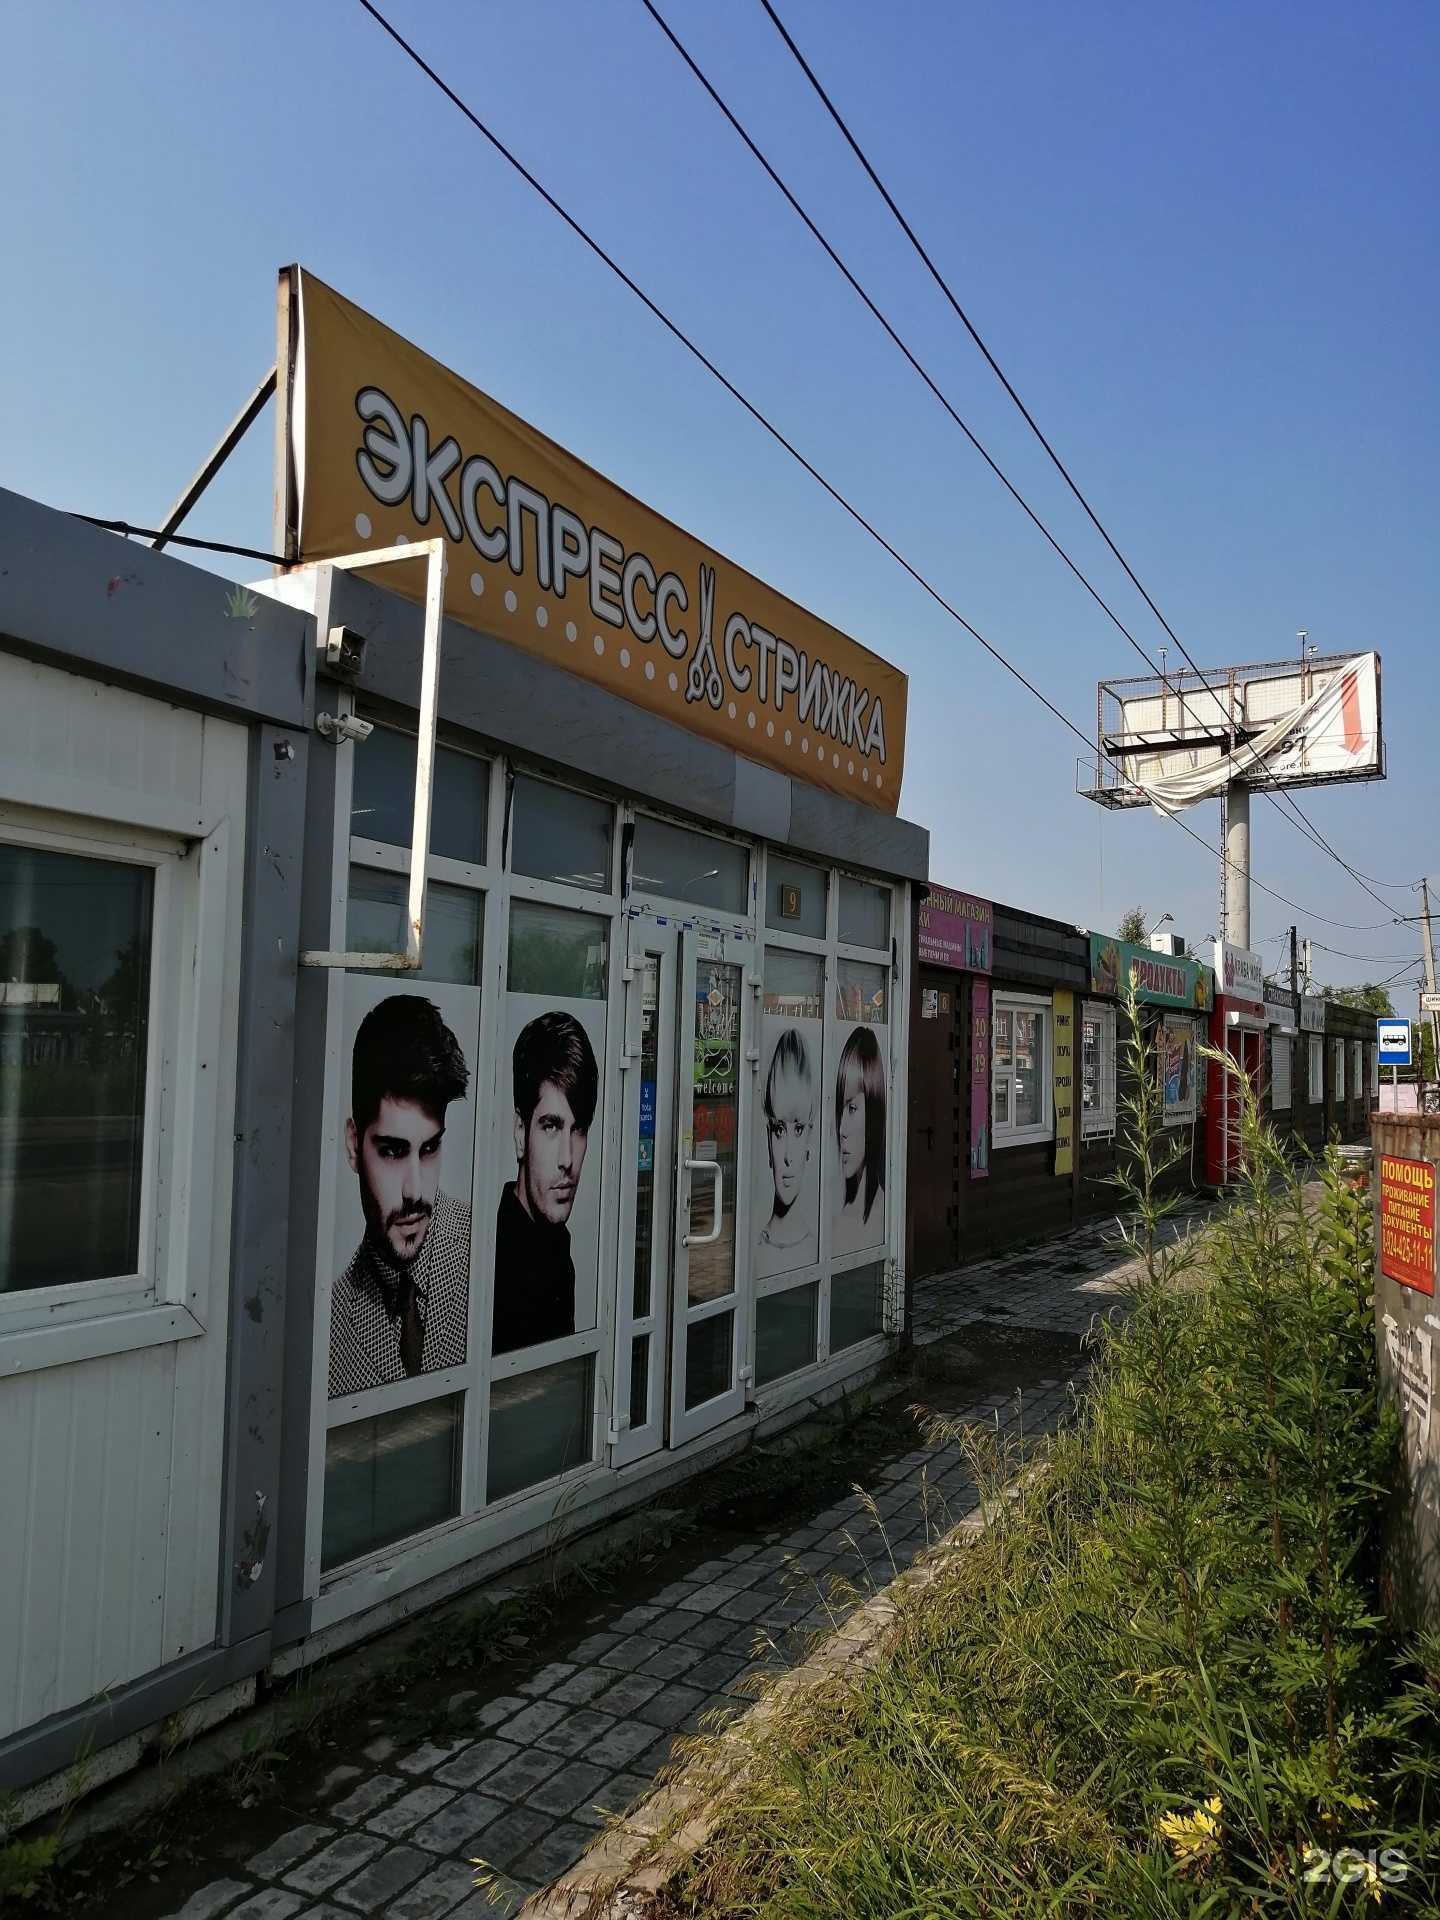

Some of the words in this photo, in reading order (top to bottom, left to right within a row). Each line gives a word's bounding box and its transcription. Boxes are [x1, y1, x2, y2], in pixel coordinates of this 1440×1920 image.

[355, 385, 688, 659] ЭКСПРЕСС
[723, 611, 888, 766] СТРИЖКА
[954, 900, 990, 924] МАГАЗИН
[1131, 956, 1187, 999] ПРОДУКТЫ
[975, 1018, 986, 1038] 10
[975, 1054, 986, 1073] 19
[694, 1078, 735, 1095] welcome
[1382, 1160, 1433, 1191] ПОМОЩЬ
[1382, 1183, 1430, 1208] ПРОЖИВАНИЕ
[1388, 1200, 1421, 1222] ПИТАНИЕ
[1382, 1213, 1433, 1240] ДОКУМЕНТЫ
